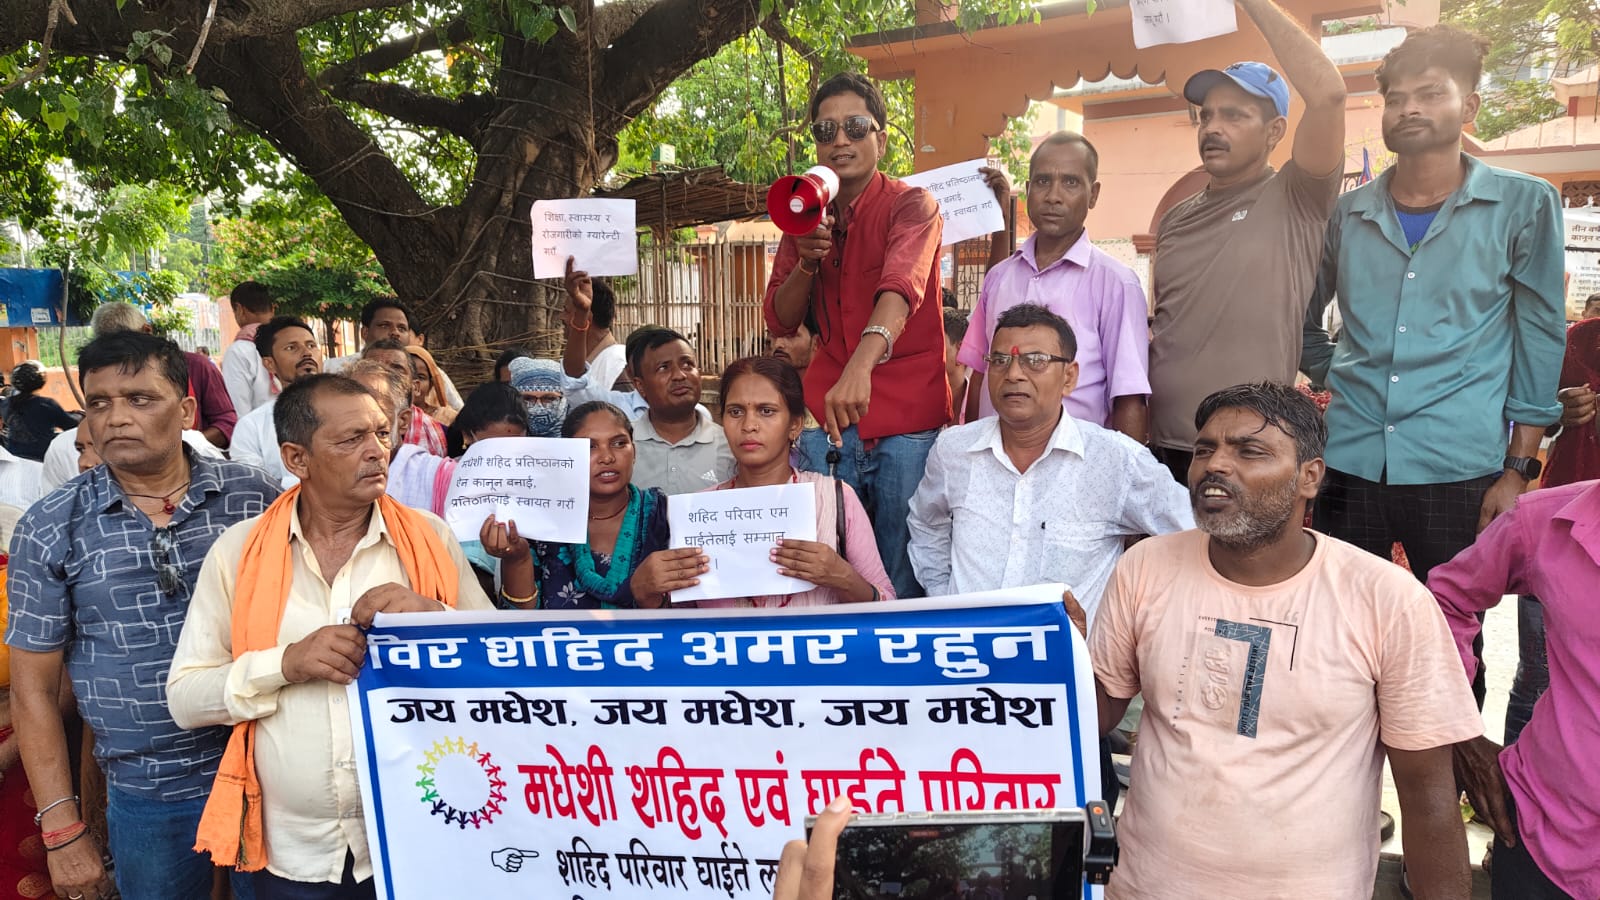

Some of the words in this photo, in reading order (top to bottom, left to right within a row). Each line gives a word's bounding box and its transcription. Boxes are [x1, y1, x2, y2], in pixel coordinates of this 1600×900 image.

[605, 214, 611, 223] र
[541, 228, 582, 240] रोजगारीको
[461, 456, 483, 468] मधेशी
[486, 455, 512, 469] शहिद
[515, 454, 574, 469] प्रतिष्ठानको
[472, 478, 503, 491] कानून
[516, 497, 552, 509] स्वायत
[688, 508, 719, 524] शहिद
[725, 506, 764, 521] परिवार
[770, 507, 789, 518] एम
[366, 634, 468, 671] विर
[480, 627, 663, 671] शहिद
[681, 628, 858, 666] अमर
[874, 624, 1060, 678] रहुन
[387, 698, 456, 724] जय
[590, 699, 667, 725] जय
[821, 698, 909, 726] जय
[926, 687, 1056, 728] मधेश
[517, 743, 618, 827] मधेशी
[625, 746, 729, 840] शहिद
[735, 750, 791, 827] एवं
[556, 836, 611, 891] शहिद
[614, 837, 689, 892] परिवार
[692, 841, 751, 899] घाईते
